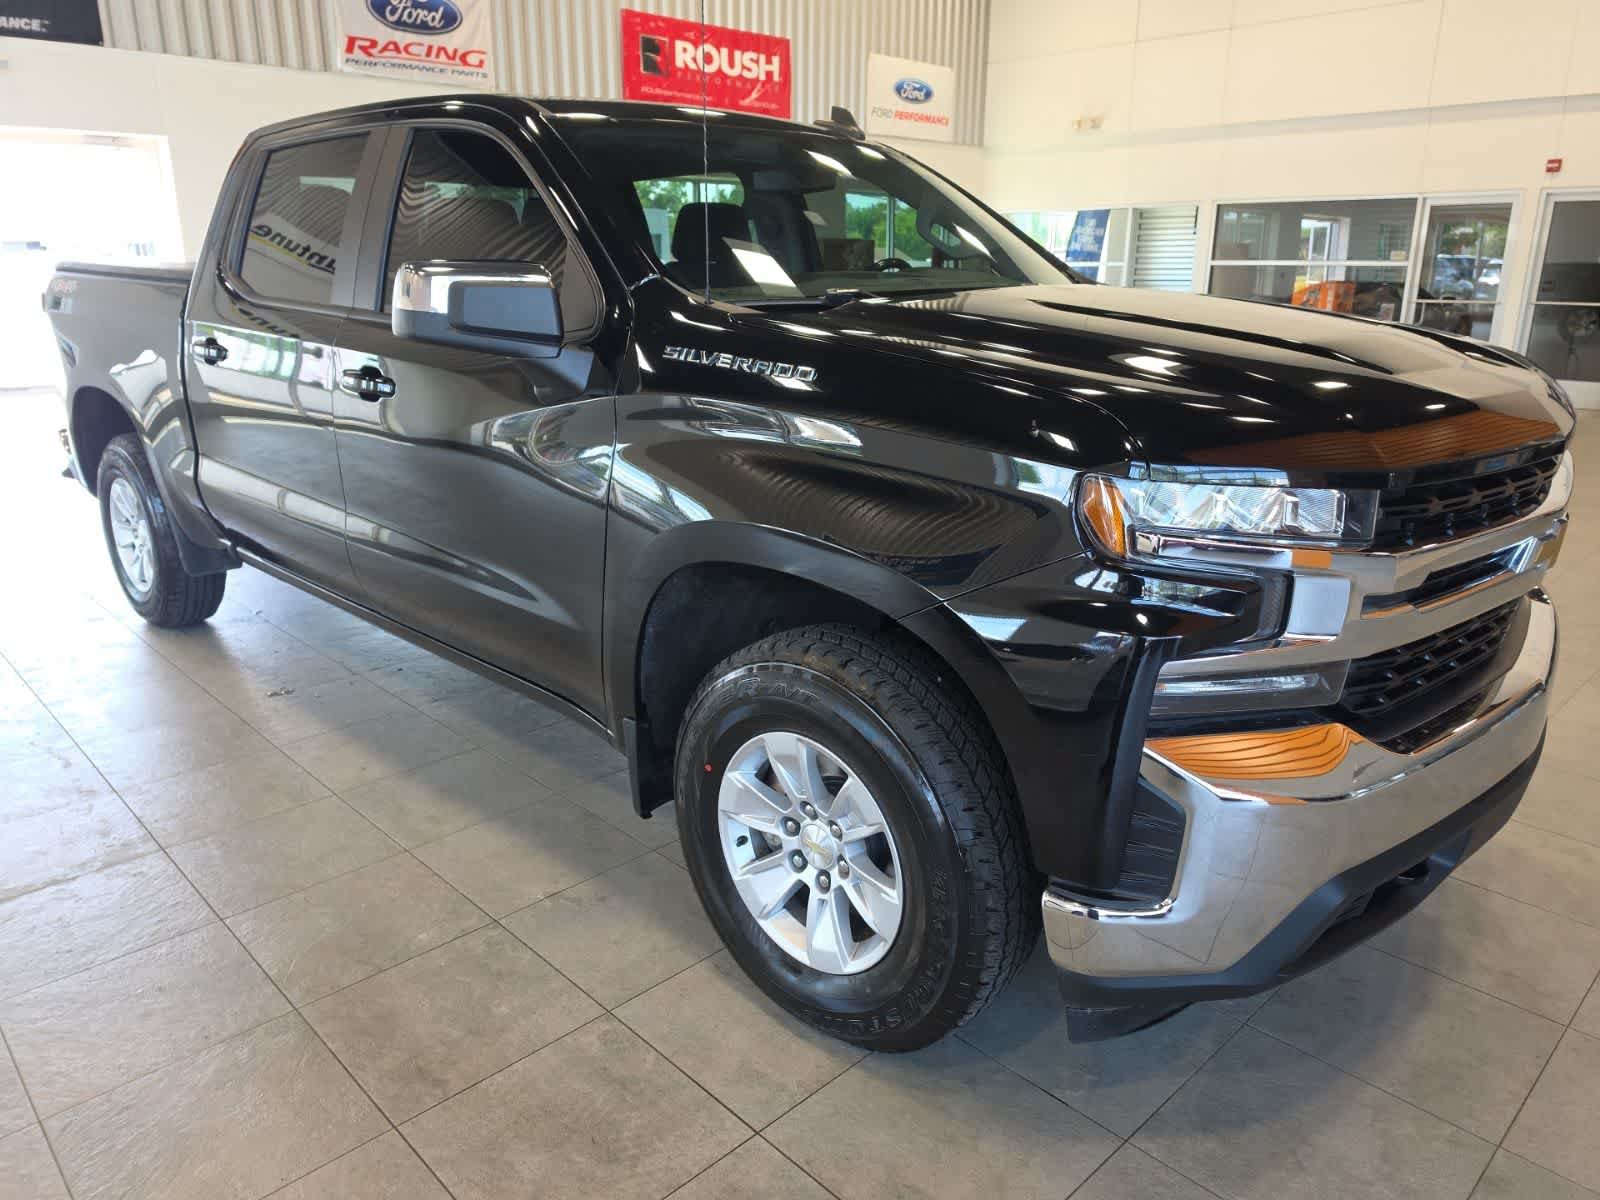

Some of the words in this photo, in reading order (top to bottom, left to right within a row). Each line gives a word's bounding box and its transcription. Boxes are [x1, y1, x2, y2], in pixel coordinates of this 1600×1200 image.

[385, 0, 445, 28] Ford
[344, 35, 487, 68] RACING
[674, 40, 780, 82] ROUSH
[345, 57, 448, 75] PERFORMANCE
[450, 68, 488, 79] PARTS
[900, 81, 926, 101] Ford
[871, 106, 893, 119] FORD
[894, 110, 950, 127] PERFORMANCE
[662, 345, 818, 382] SILVERADO
